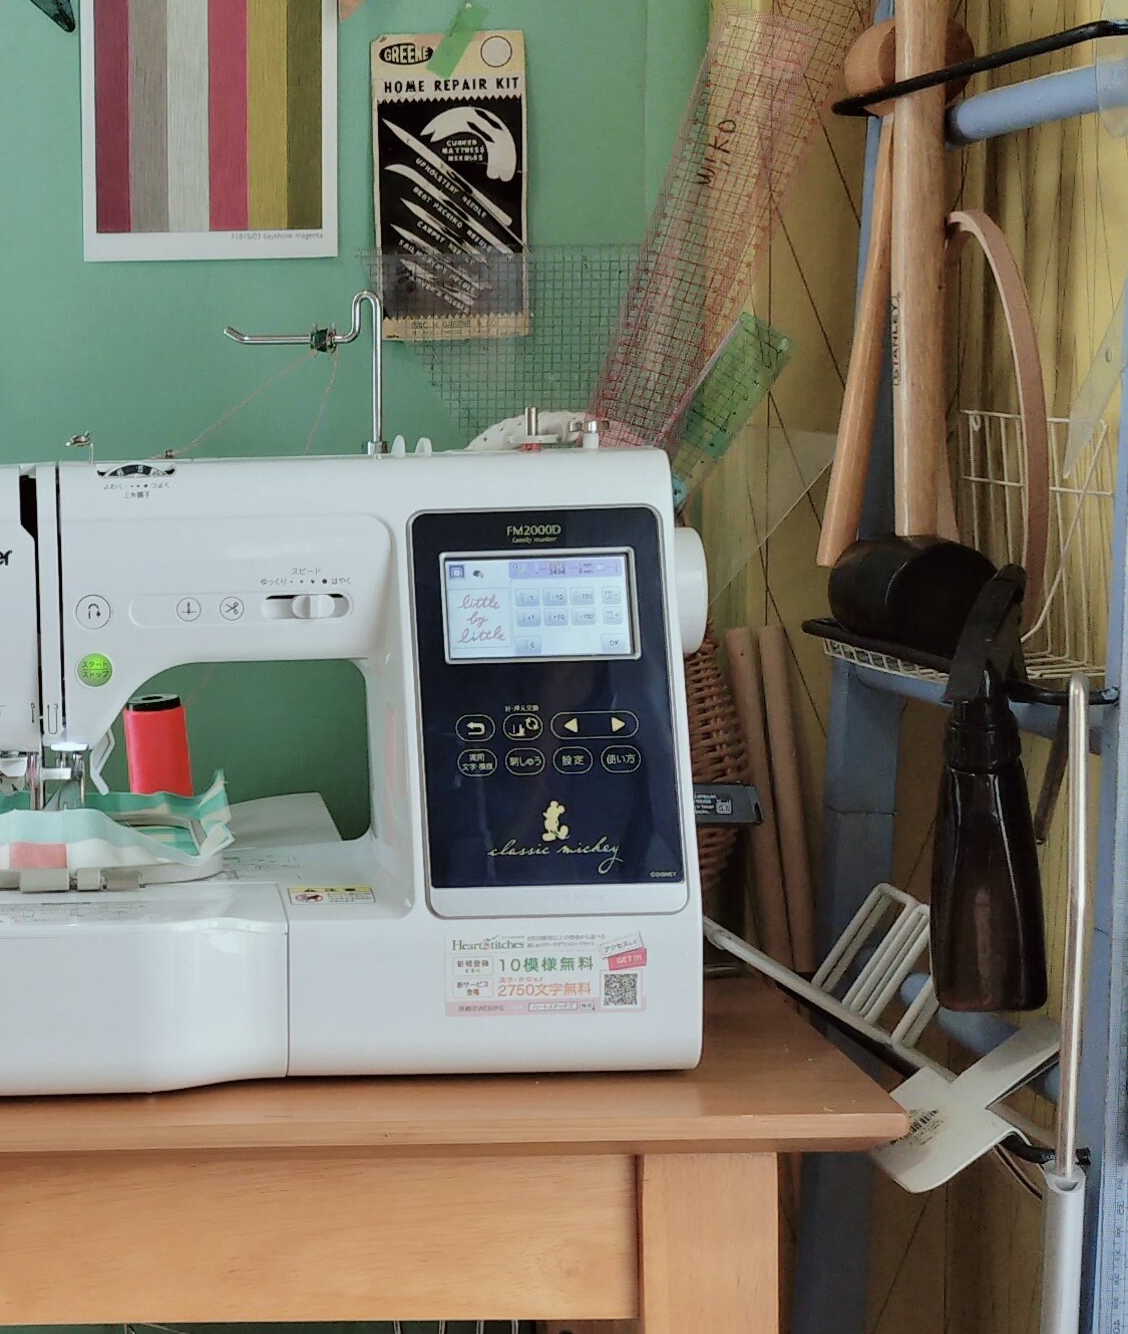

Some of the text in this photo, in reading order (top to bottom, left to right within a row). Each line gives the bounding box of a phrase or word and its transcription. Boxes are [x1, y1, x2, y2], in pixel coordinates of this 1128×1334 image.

[383, 44, 429, 64] GREENE
[384, 76, 520, 94] HOME REPAIR KIT
[506, 524, 562, 537] FM2000D
[291, 567, 321, 576] スピード
[260, 577, 287, 586] ゆっくり
[331, 577, 352, 585] はやく
[457, 593, 501, 609] little
[466, 611, 489, 627] by
[457, 626, 505, 644] little
[82, 670, 110, 678] ストップ
[509, 756, 542, 767] 刺しゅう
[561, 754, 585, 766] 設定
[606, 753, 636, 764] 使い方
[487, 836, 624, 874] classic mickey
[498, 955, 593, 972] 10模様無料
[456, 980, 489, 989] 新サービス
[497, 982, 592, 997] 2750文字無料
